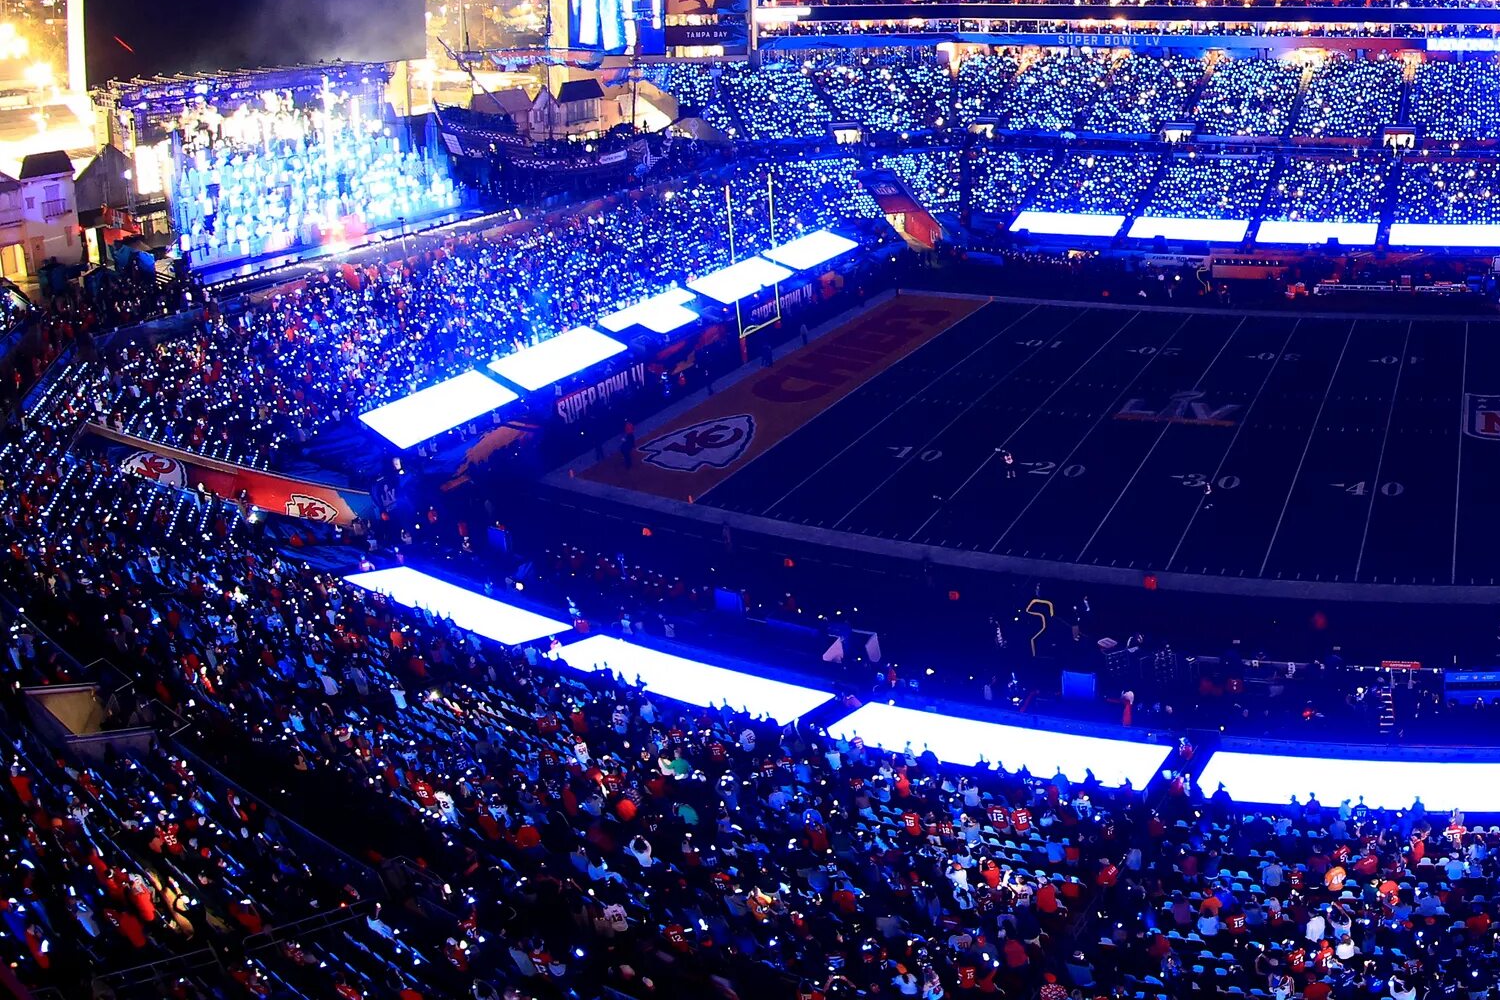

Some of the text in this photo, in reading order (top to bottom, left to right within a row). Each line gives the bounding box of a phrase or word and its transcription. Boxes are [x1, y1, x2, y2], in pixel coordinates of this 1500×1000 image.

[1058, 35, 1160, 46] SUPER BOWL LV
[752, 304, 950, 403] CHIEFS
[557, 388, 597, 425] SUPER
[597, 376, 630, 407] BOWL
[891, 446, 943, 462] 10
[1026, 461, 1087, 478] 20
[1181, 473, 1241, 489] 30
[1345, 481, 1404, 497] 40
[905, 818, 915, 827] 15
[992, 813, 1004, 822] 12
[1018, 816, 1027, 824] 15
[164, 835, 178, 846] 55
[1234, 920, 1243, 928] 15
[672, 934, 683, 942] 12
